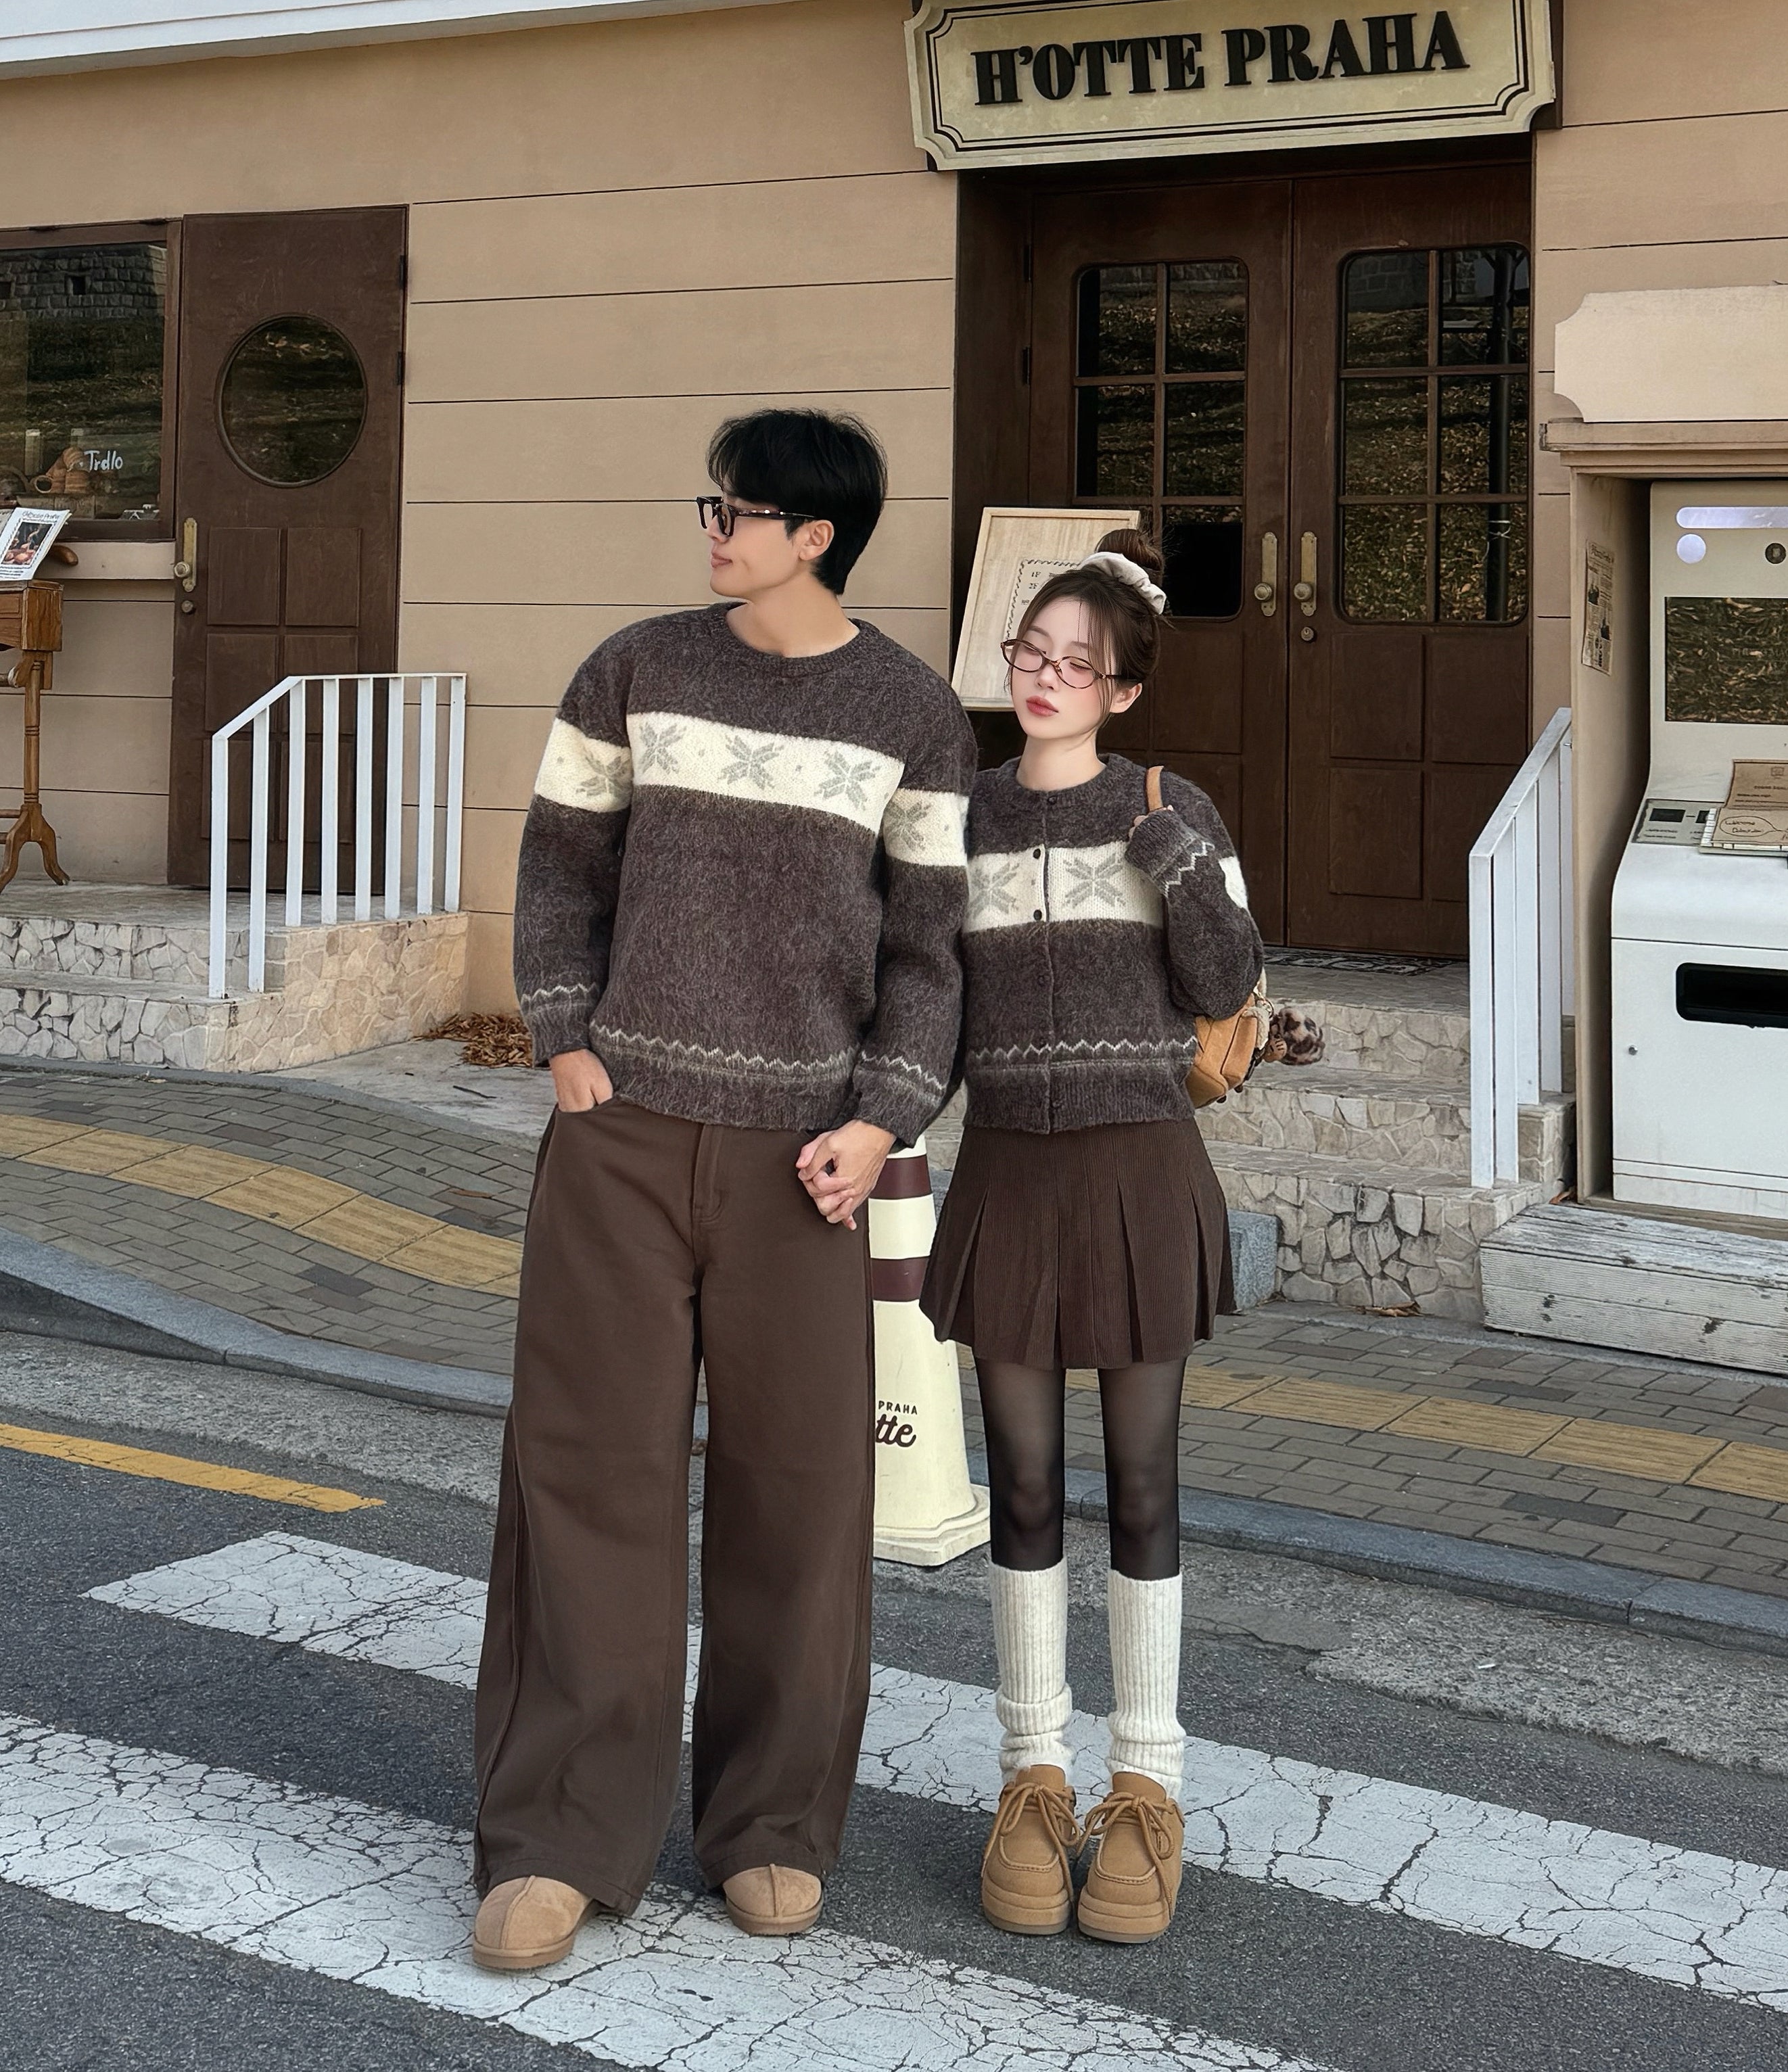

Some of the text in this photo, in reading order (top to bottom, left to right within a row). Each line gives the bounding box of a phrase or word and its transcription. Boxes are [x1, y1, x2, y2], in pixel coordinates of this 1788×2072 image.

[970, 11, 1470, 105] H'OTTE PRAHA
[84, 450, 123, 471] Trdlo
[878, 1400, 918, 1415] PRAHA
[876, 1413, 917, 1447] tte
